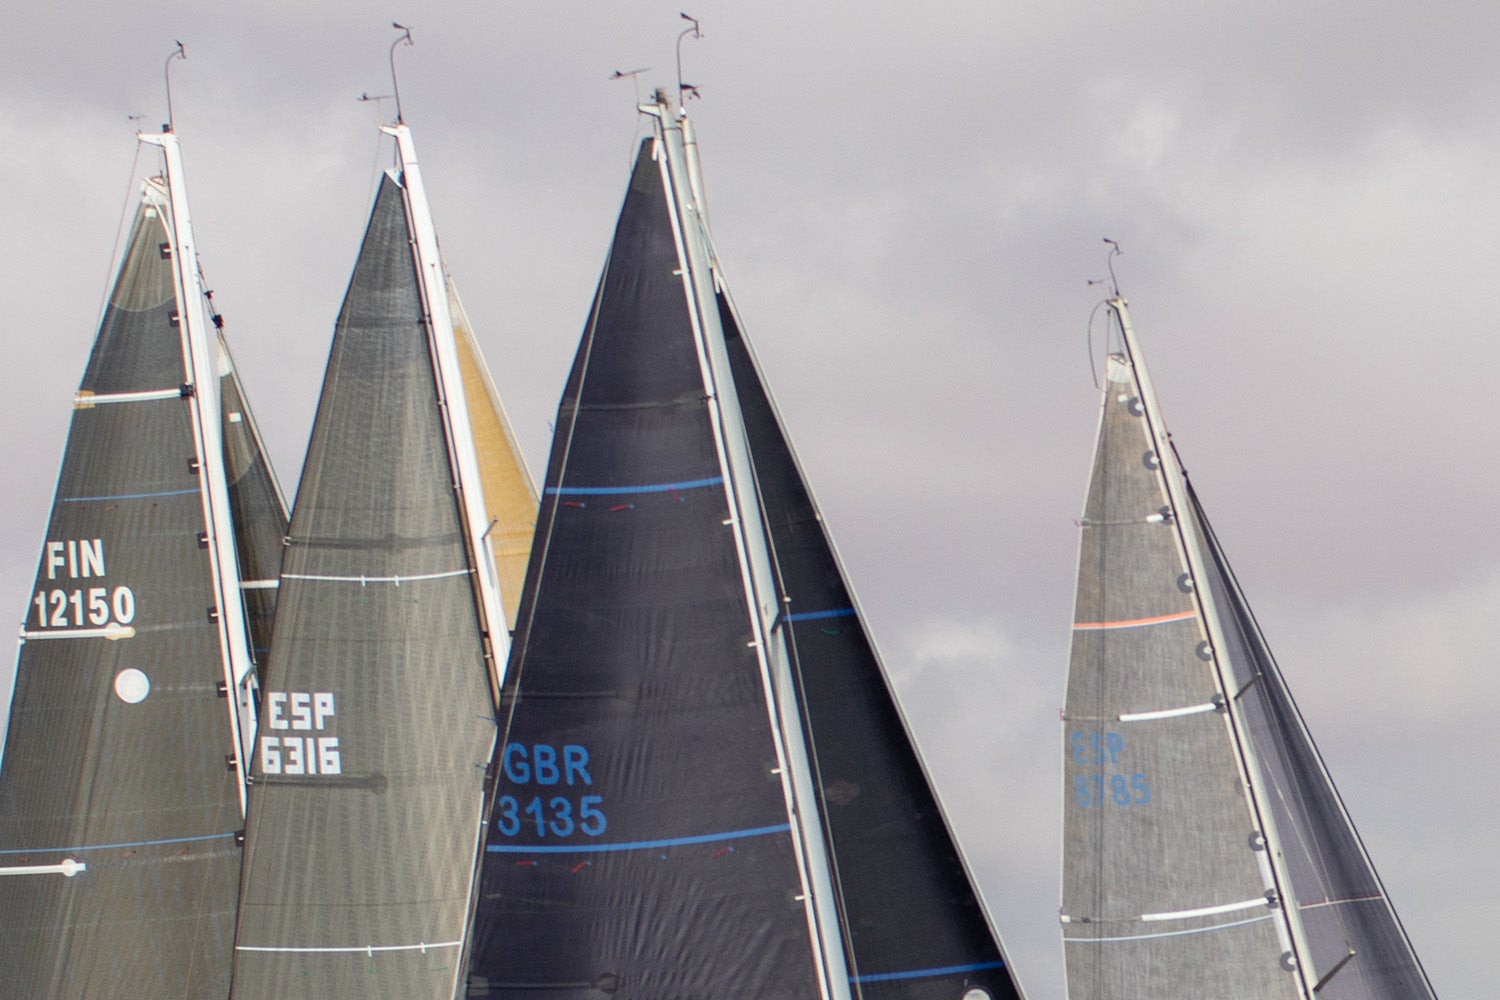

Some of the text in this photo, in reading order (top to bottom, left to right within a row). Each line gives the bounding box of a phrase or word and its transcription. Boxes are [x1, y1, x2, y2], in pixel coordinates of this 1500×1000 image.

[46, 538, 106, 580] FIN
[34, 586, 136, 627] 12150
[268, 692, 335, 730] ESP
[260, 736, 342, 775] 6316
[504, 742, 593, 786] GBR
[1070, 732, 1125, 765] ESP
[1073, 772, 1152, 809] 8785
[498, 795, 608, 838] 3135
